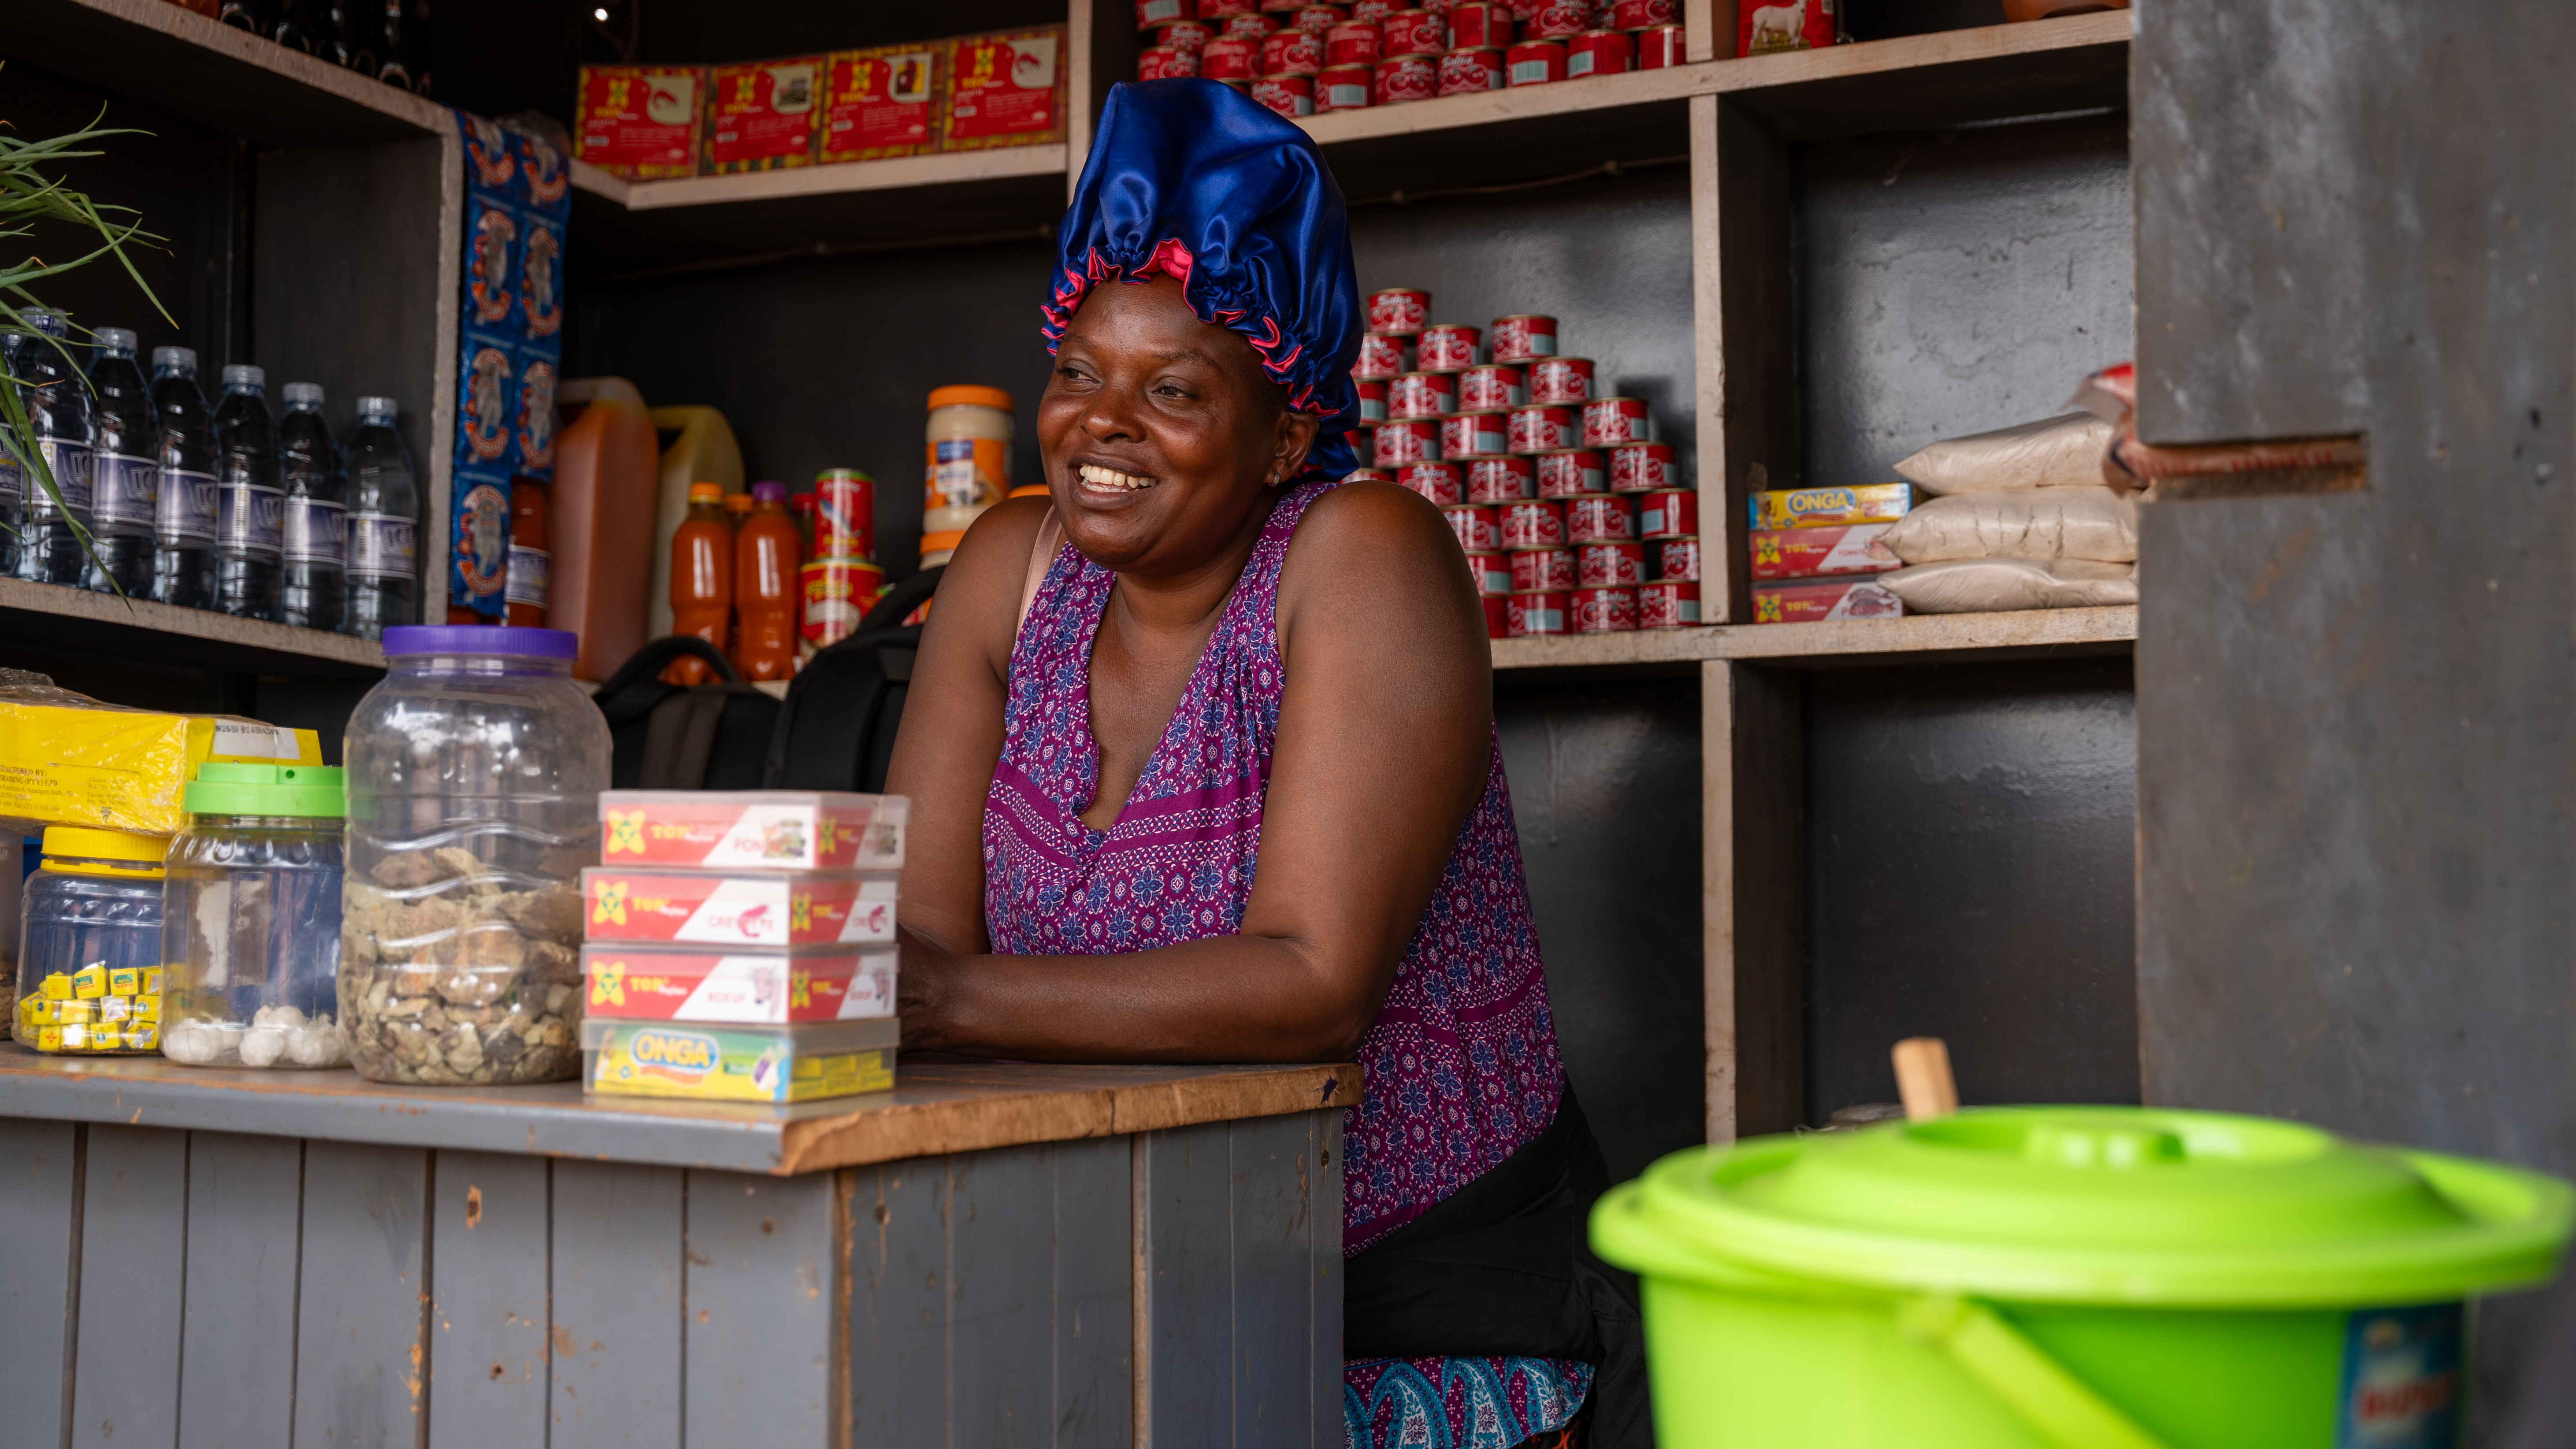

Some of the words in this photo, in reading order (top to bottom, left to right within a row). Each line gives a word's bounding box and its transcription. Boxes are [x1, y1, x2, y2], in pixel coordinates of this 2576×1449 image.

[1377, 294, 1412, 307] Salsa
[1363, 338, 1388, 349] alsa
[1413, 466, 1447, 478] Salsa
[1792, 491, 1849, 511] ONGA
[1786, 543, 1808, 554] TOP
[1786, 601, 1810, 612] TOP
[1841, 605, 1894, 618] POISSON
[0, 765, 33, 775] FACTURED
[25, 778, 43, 787] (PTY)
[651, 825, 689, 840] TOP
[631, 897, 666, 913] TOP
[629, 976, 665, 993] TOP
[811, 980, 831, 994] TOP
[635, 1034, 710, 1067] ONGA
